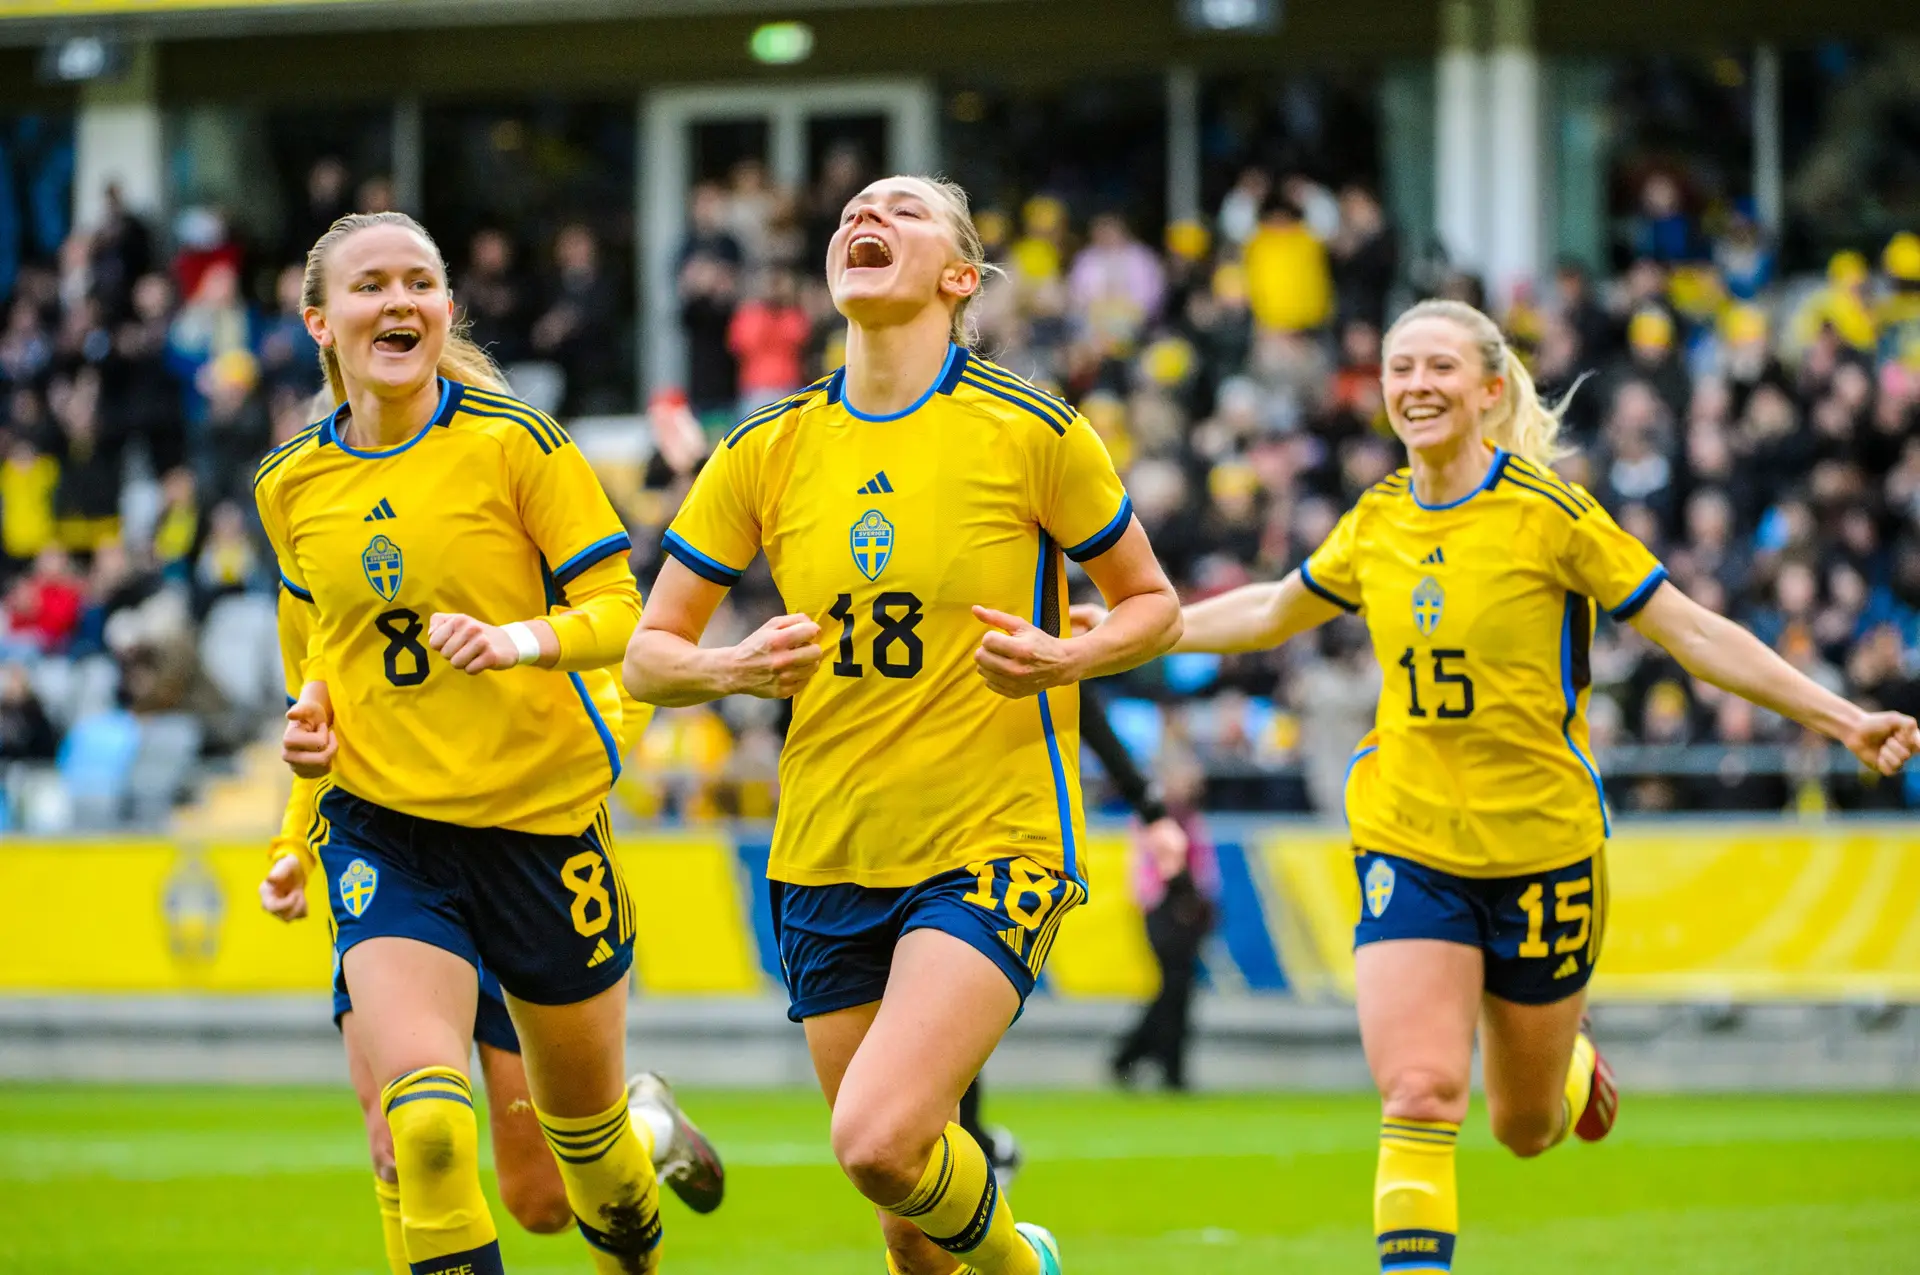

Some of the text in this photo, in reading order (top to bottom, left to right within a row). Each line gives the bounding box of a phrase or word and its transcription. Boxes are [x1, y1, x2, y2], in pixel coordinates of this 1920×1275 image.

[375, 607, 430, 687] 8
[828, 591, 924, 679] 18
[1399, 648, 1474, 719] 15
[560, 850, 612, 938] 8
[962, 855, 1059, 931] 18
[1517, 876, 1591, 958] 15
